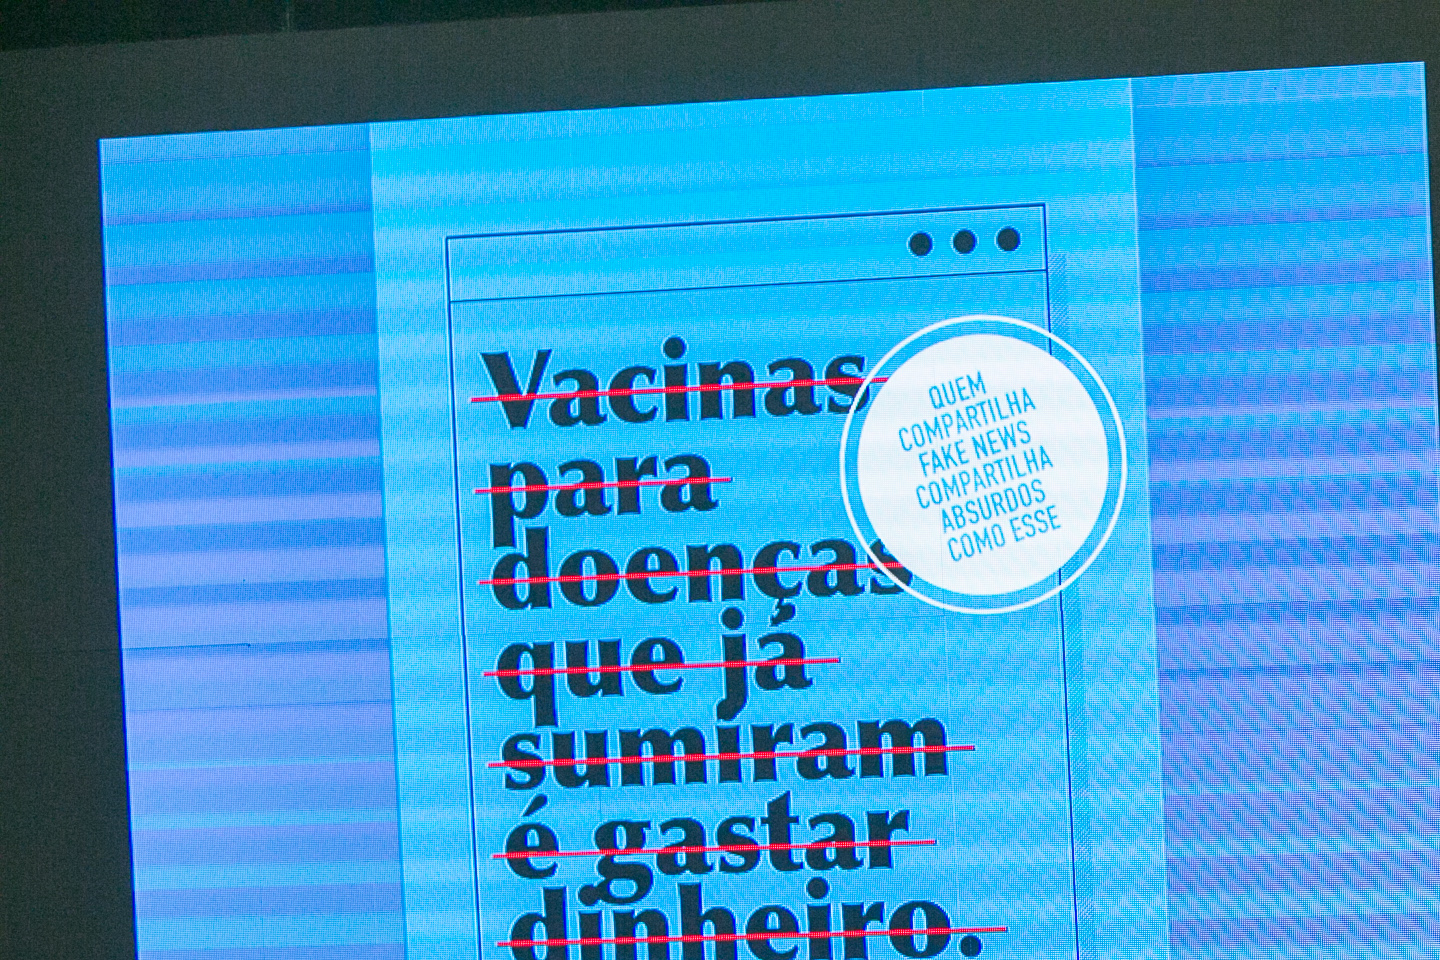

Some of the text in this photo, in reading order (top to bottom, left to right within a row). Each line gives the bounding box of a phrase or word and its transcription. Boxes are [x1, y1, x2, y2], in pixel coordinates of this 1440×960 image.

[480, 336, 870, 430] Vacinas
[928, 371, 986, 409] QUEM
[898, 387, 1036, 452] COMPARTILHA
[918, 420, 1031, 477] FAKE NEWS
[489, 450, 718, 548] para
[915, 445, 1054, 509] COMPARTILHA
[940, 478, 1046, 534] ABSURDOS
[946, 504, 1061, 562] COMO ESSE
[491, 525, 913, 627] doenças
[496, 603, 813, 726] que já
[502, 716, 949, 790] sumiram
[504, 790, 910, 905] é gastar
